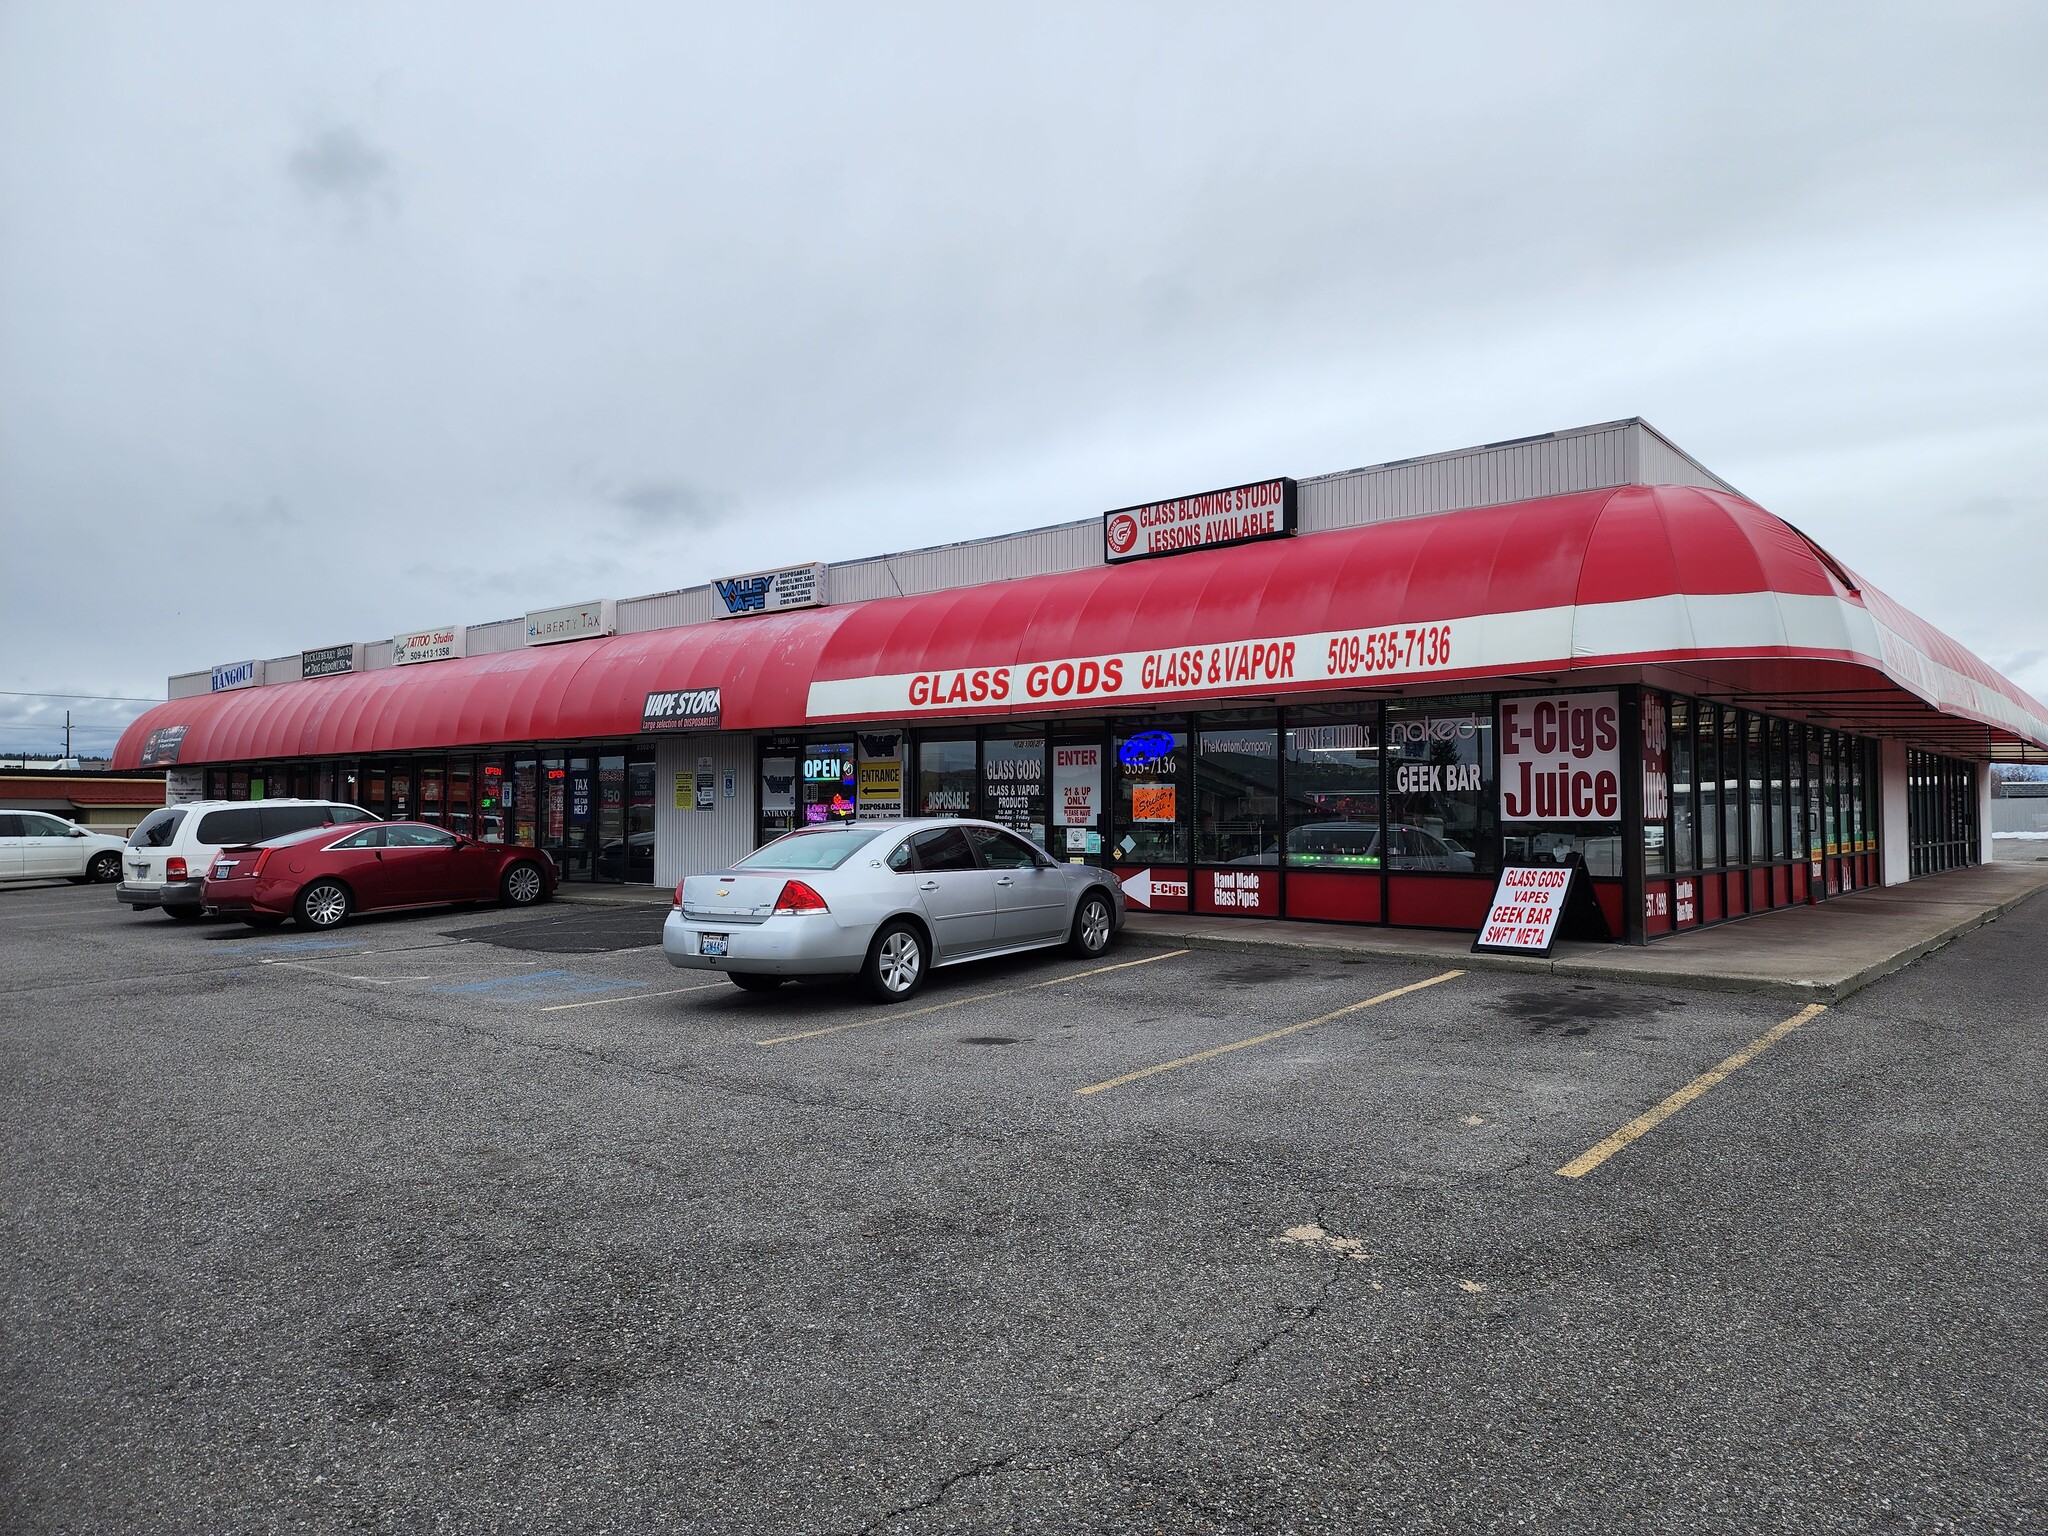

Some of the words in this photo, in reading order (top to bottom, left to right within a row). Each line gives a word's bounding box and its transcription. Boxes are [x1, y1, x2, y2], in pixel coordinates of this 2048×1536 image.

[1140, 502, 1175, 529] GLASS
[1179, 491, 1231, 521] BLOWING
[1236, 481, 1281, 511] STUDIO
[1148, 523, 1201, 554] LESSONS
[1205, 511, 1274, 544] AVAILABLE
[780, 569, 811, 579] DISPOSABLES
[715, 575, 775, 597] VALLEY
[725, 594, 765, 613] VAPE
[536, 619, 578, 635] LIBERTY
[581, 612, 600, 628] TAX
[407, 635, 430, 648] TATTOO
[433, 632, 454, 644] Studio
[410, 647, 450, 660] 509-413-1358
[909, 668, 1009, 705] GLASS
[1027, 659, 1123, 697] GODS
[1142, 648, 1203, 689] GLASS
[1327, 625, 1451, 675] 509-535-7136
[212, 662, 254, 691] HANGOUT
[645, 693, 678, 717] VAPE
[643, 721, 655, 730] Large
[656, 719, 677, 728] selection
[1391, 712, 1476, 743] naked
[1502, 701, 1617, 758] E-Cigs
[1057, 750, 1097, 766] ENTER
[485, 767, 502, 776] OPEN
[548, 770, 565, 779] OPEN
[804, 759, 840, 778] OPEN
[861, 769, 899, 782] ENTRANCE
[986, 760, 1014, 780] GLASS
[1016, 759, 1041, 780] GODS
[574, 779, 588, 790] TAX
[1397, 765, 1441, 792] GEEK
[1446, 764, 1481, 791] BAR
[603, 789, 620, 802] $50
[988, 785, 1009, 796] GLASS
[1010, 785, 1015, 795] &
[1017, 785, 1040, 796] VAPOR
[1064, 787, 1072, 796] 21
[1074, 787, 1080, 796] &
[1081, 786, 1091, 796] UP
[1504, 762, 1617, 817] Juice
[859, 803, 901, 811] DISPOSABLES
[929, 792, 969, 810] DISPOSABLE
[999, 797, 1028, 808] PRODUCTS
[1067, 796, 1087, 805] ONLY
[573, 805, 588, 815] HELP
[1149, 803, 1166, 816] Sale
[1214, 872, 1235, 888] Hand
[1236, 872, 1259, 889] Made
[1505, 870, 1537, 887] GLASS
[1538, 871, 1566, 887] GODS
[1151, 884, 1186, 895] E-Cigs
[1214, 888, 1235, 906] Glass
[1237, 889, 1259, 908] Pipes
[1514, 891, 1549, 903] VAPES
[1492, 906, 1525, 923] GEEK
[1526, 907, 1552, 924] BAR
[1485, 926, 1515, 943] SWFT
[1515, 928, 1544, 945] META
